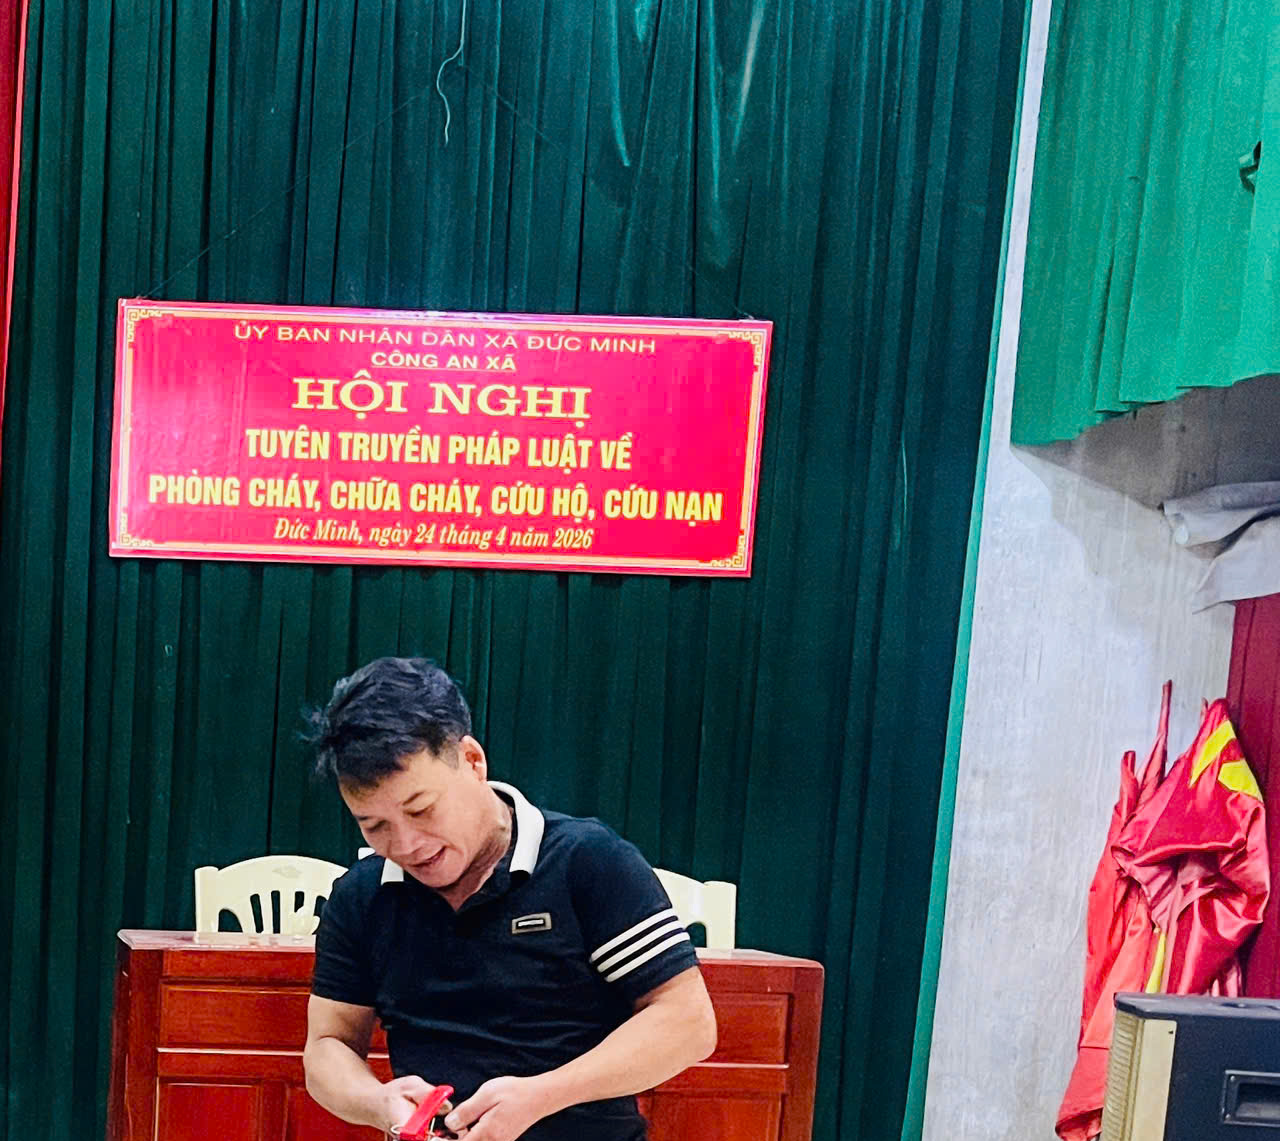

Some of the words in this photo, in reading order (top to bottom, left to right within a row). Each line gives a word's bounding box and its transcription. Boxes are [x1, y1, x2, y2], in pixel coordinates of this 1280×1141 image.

[234, 321, 269, 339] ỦY
[277, 326, 330, 342] BAN
[339, 327, 412, 345] NHÂN
[422, 329, 475, 347] DÂN
[484, 332, 518, 348] XÃ
[527, 333, 581, 351] ĐỨC
[590, 337, 656, 353] MINH
[371, 349, 439, 368] CÔNG
[446, 354, 478, 369] AN
[486, 353, 517, 370] XÃ
[291, 369, 409, 420] HỘI
[427, 382, 592, 428] NGHỊ
[245, 424, 330, 460] TUYÊN
[338, 425, 441, 464] TRUYỀN
[448, 430, 520, 465] PHÁP
[527, 433, 593, 475] LUẬT
[600, 431, 633, 470] VỀ
[149, 468, 240, 506] PHÒNG
[248, 473, 321, 512] CHÁY,
[330, 477, 401, 511] CHỮA
[409, 478, 482, 517] CHÁY,
[491, 481, 545, 516] CỨU
[552, 482, 595, 523] HỘ,
[604, 483, 658, 519] CỨU
[664, 491, 723, 527] NẠN
[273, 517, 310, 540] Đức
[312, 518, 363, 544] Minh,
[369, 522, 412, 547] ngày
[416, 523, 436, 544] 24
[439, 524, 493, 550] tháng
[495, 526, 508, 546] 4
[509, 527, 549, 547] năm
[552, 527, 594, 549] 2026
